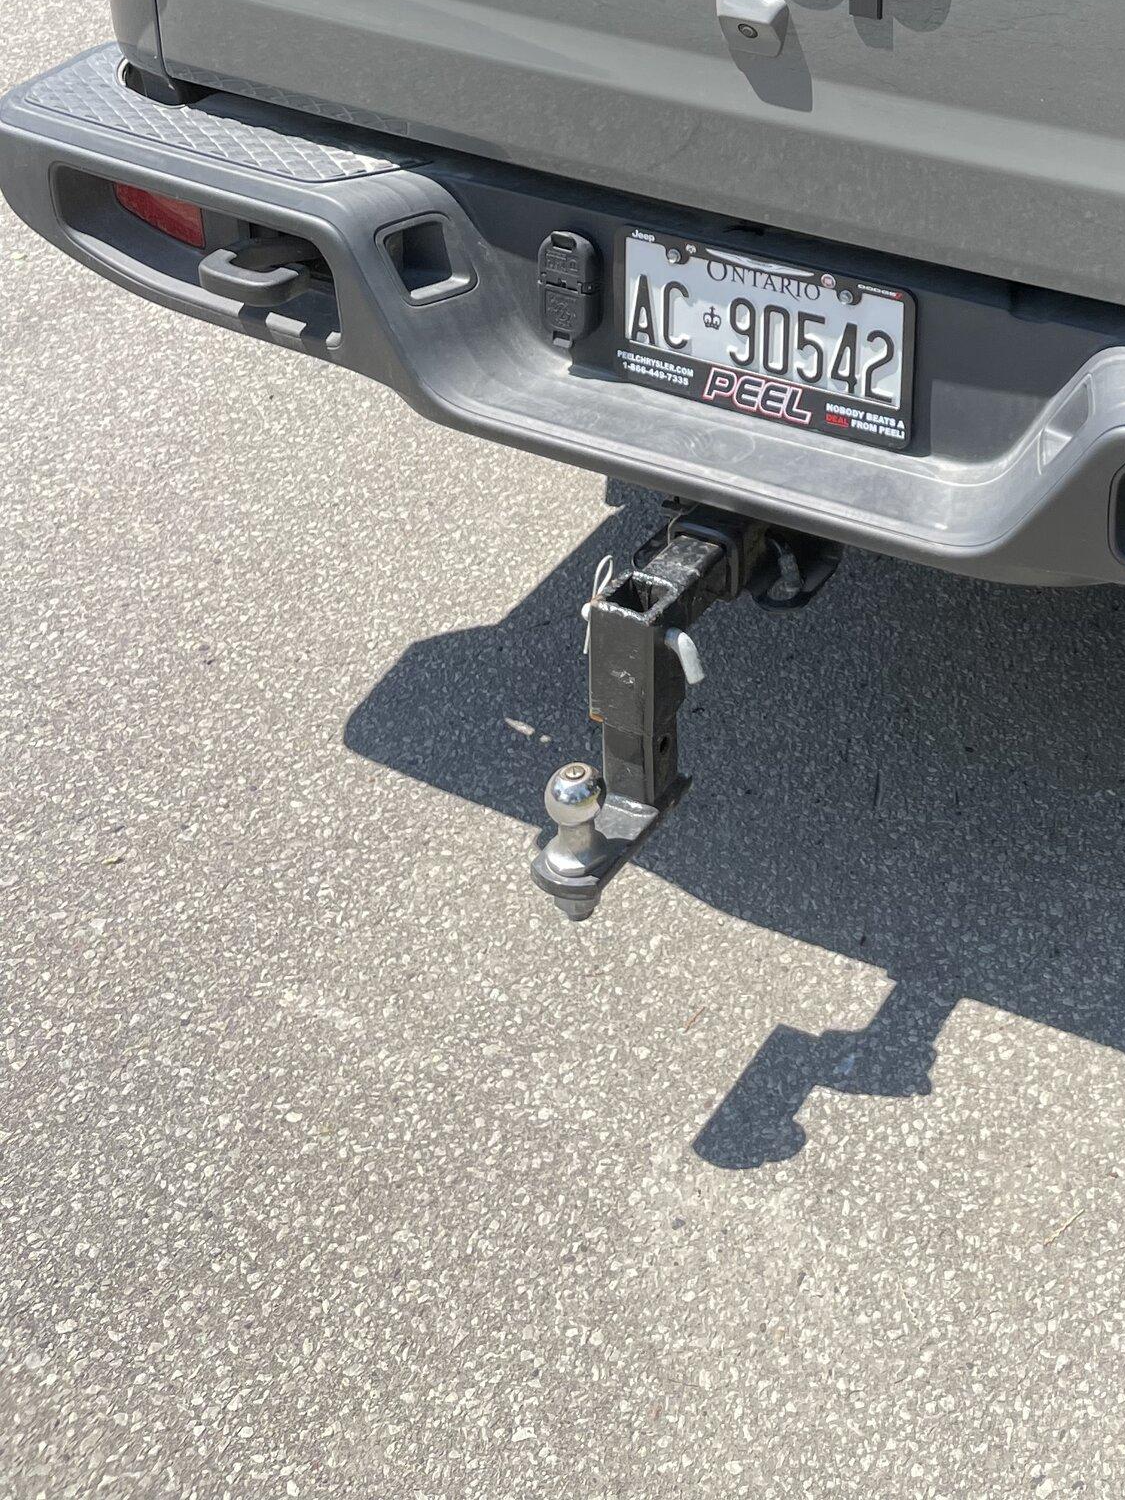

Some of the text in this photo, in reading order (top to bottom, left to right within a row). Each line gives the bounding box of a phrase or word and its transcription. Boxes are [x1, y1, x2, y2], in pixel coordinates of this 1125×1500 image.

[631, 229, 656, 243] Jeep
[706, 259, 821, 301] ONTARIO
[631, 274, 895, 404] AC 90542
[616, 349, 695, 378] PEELCHRYSLER.COM
[703, 367, 813, 425] PEEL
[825, 402, 905, 430] NOBODY BEATS A
[825, 413, 850, 427] DEAL
[850, 418, 878, 433] FROM
